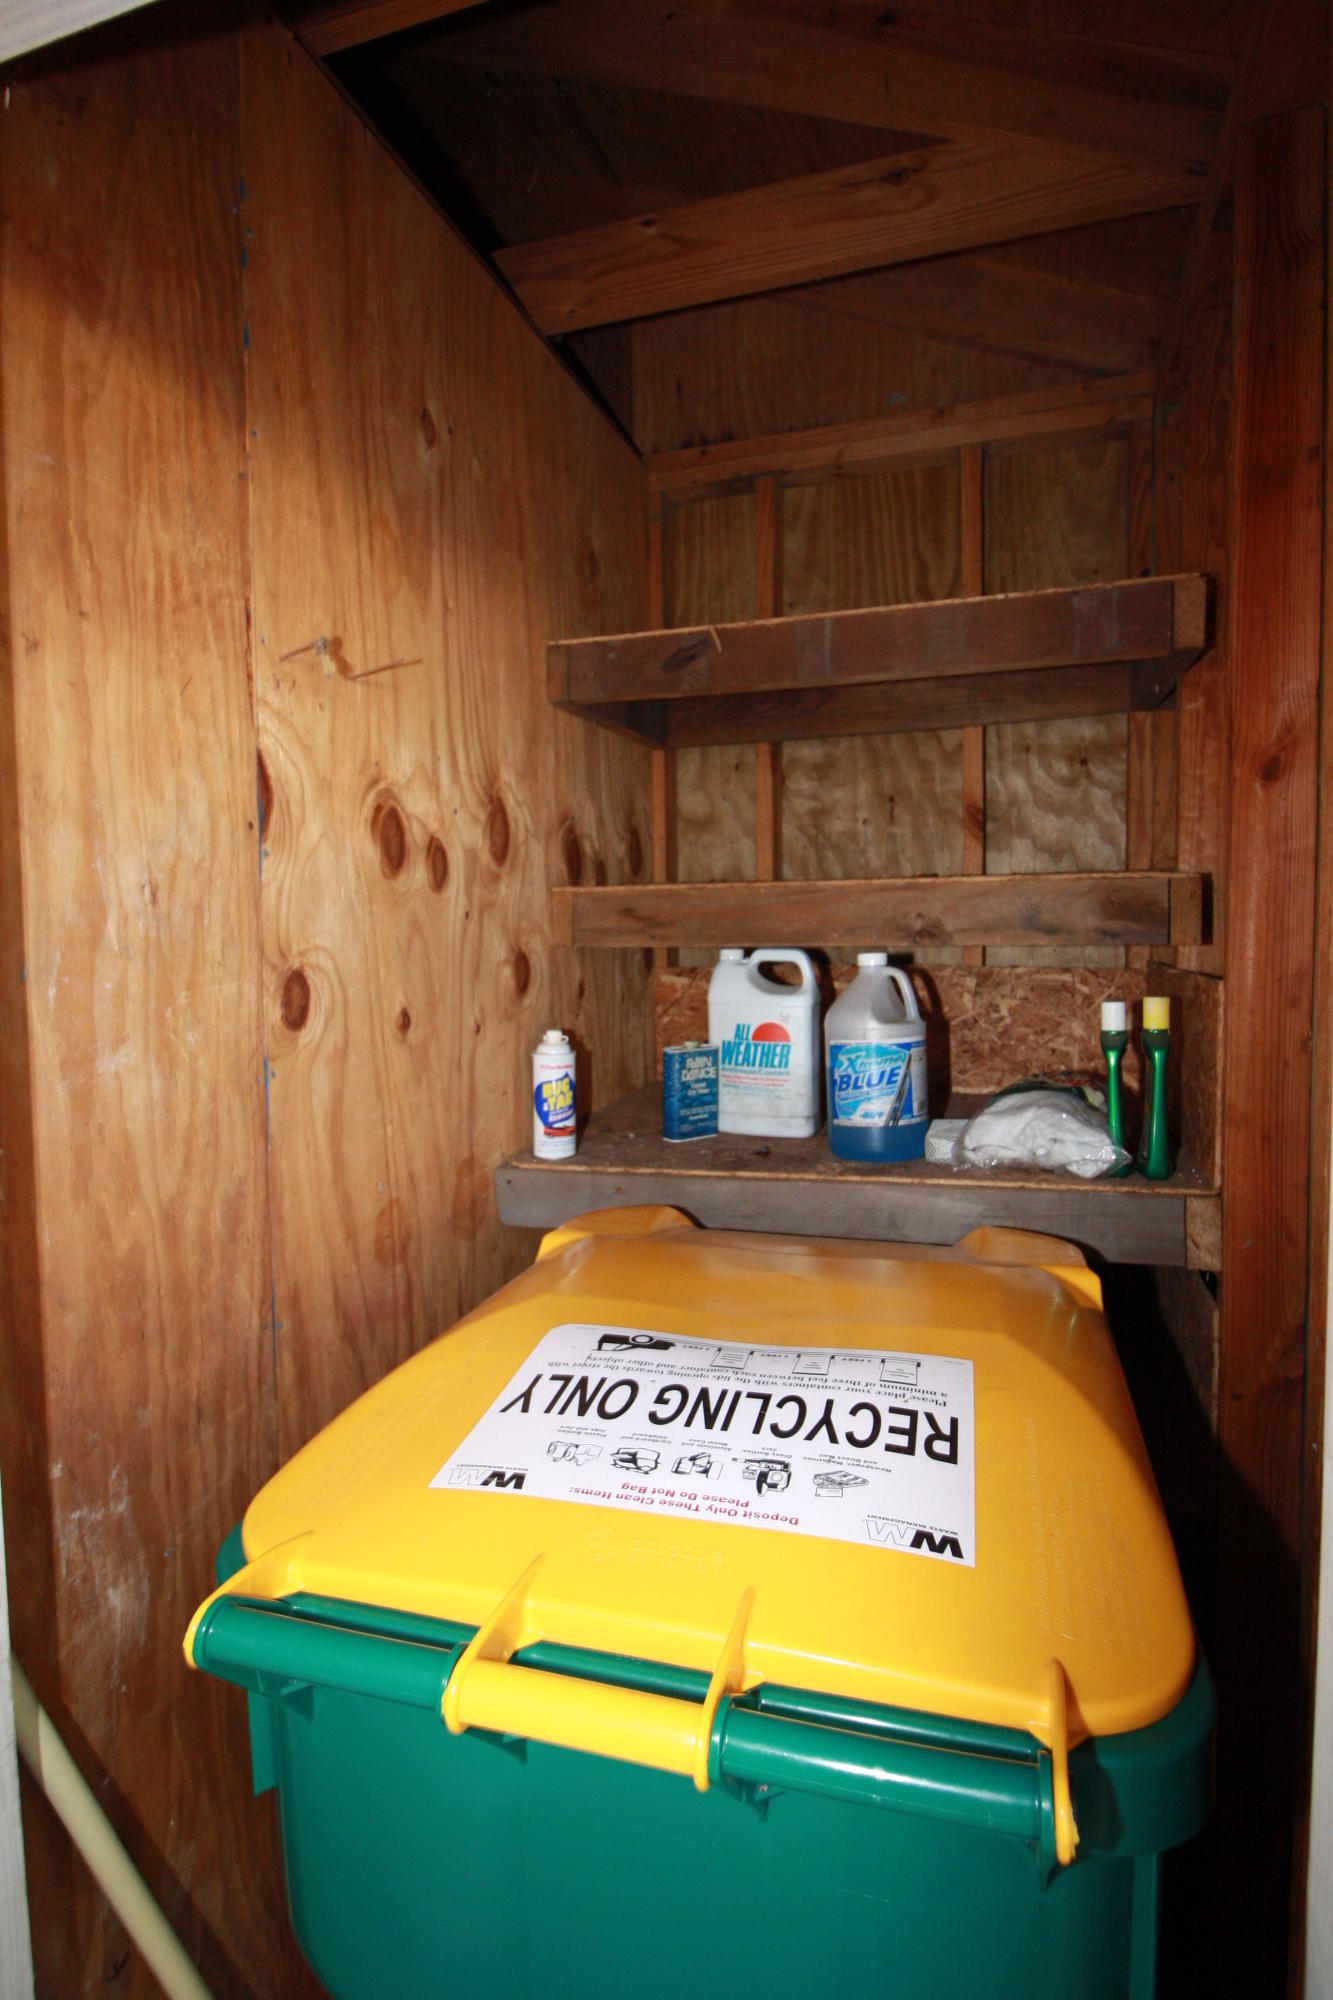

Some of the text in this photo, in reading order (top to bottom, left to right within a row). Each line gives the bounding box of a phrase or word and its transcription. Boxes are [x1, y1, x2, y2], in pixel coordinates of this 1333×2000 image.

[734, 1023, 751, 1040] ALL
[721, 1040, 791, 1069] WEATHER
[838, 1065, 902, 1092] BLUE
[542, 1077, 570, 1099] BUG
[548, 1090, 573, 1112] TAR
[623, 1367, 664, 1375] towards
[667, 1370, 708, 1378] opening
[679, 1366, 729, 1374] container
[760, 1374, 804, 1382] between
[782, 1382, 841, 1391] containers
[875, 1390, 906, 1399] place
[880, 1384, 936, 1396] minimum
[910, 1395, 946, 1407] Please
[498, 1374, 958, 1465] RECYCLING ONLY
[622, 1483, 749, 1508] Please Do Not Bag
[570, 1487, 799, 1526] Deposit Only These Clean Items:
[867, 1514, 958, 1536] WASTE MANAGEMENT
